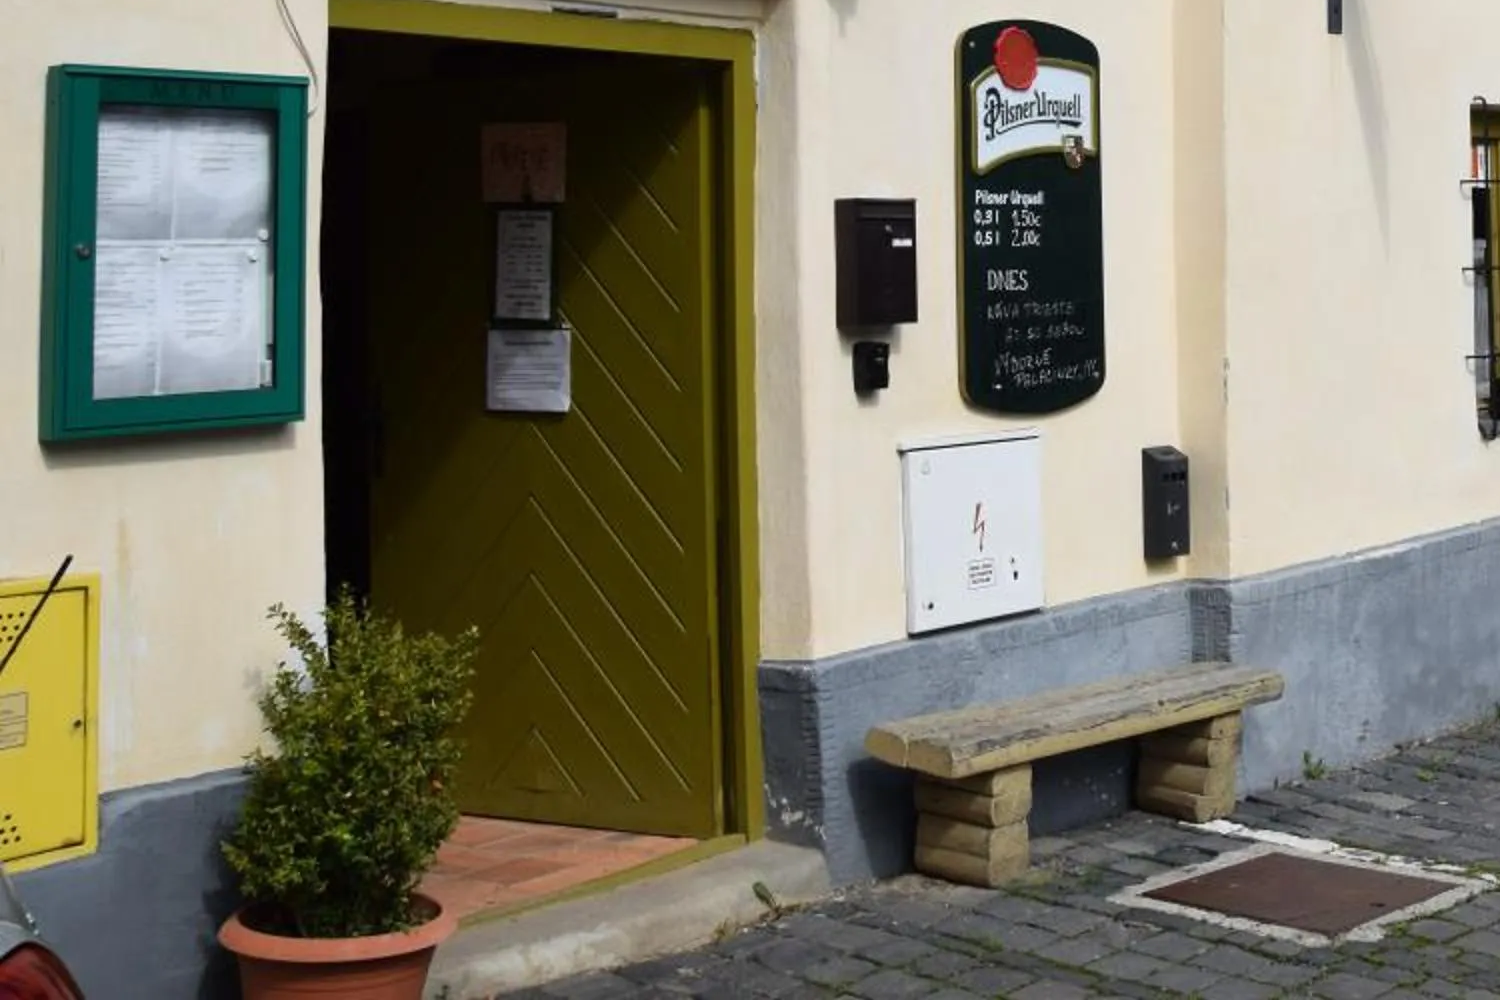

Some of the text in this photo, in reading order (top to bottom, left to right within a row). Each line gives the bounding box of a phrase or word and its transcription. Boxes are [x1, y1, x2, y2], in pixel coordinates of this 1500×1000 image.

[983, 87, 1082, 142] Pilsner Urquell
[975, 189, 1008, 206] Pilsner
[987, 269, 1029, 292] DNES
